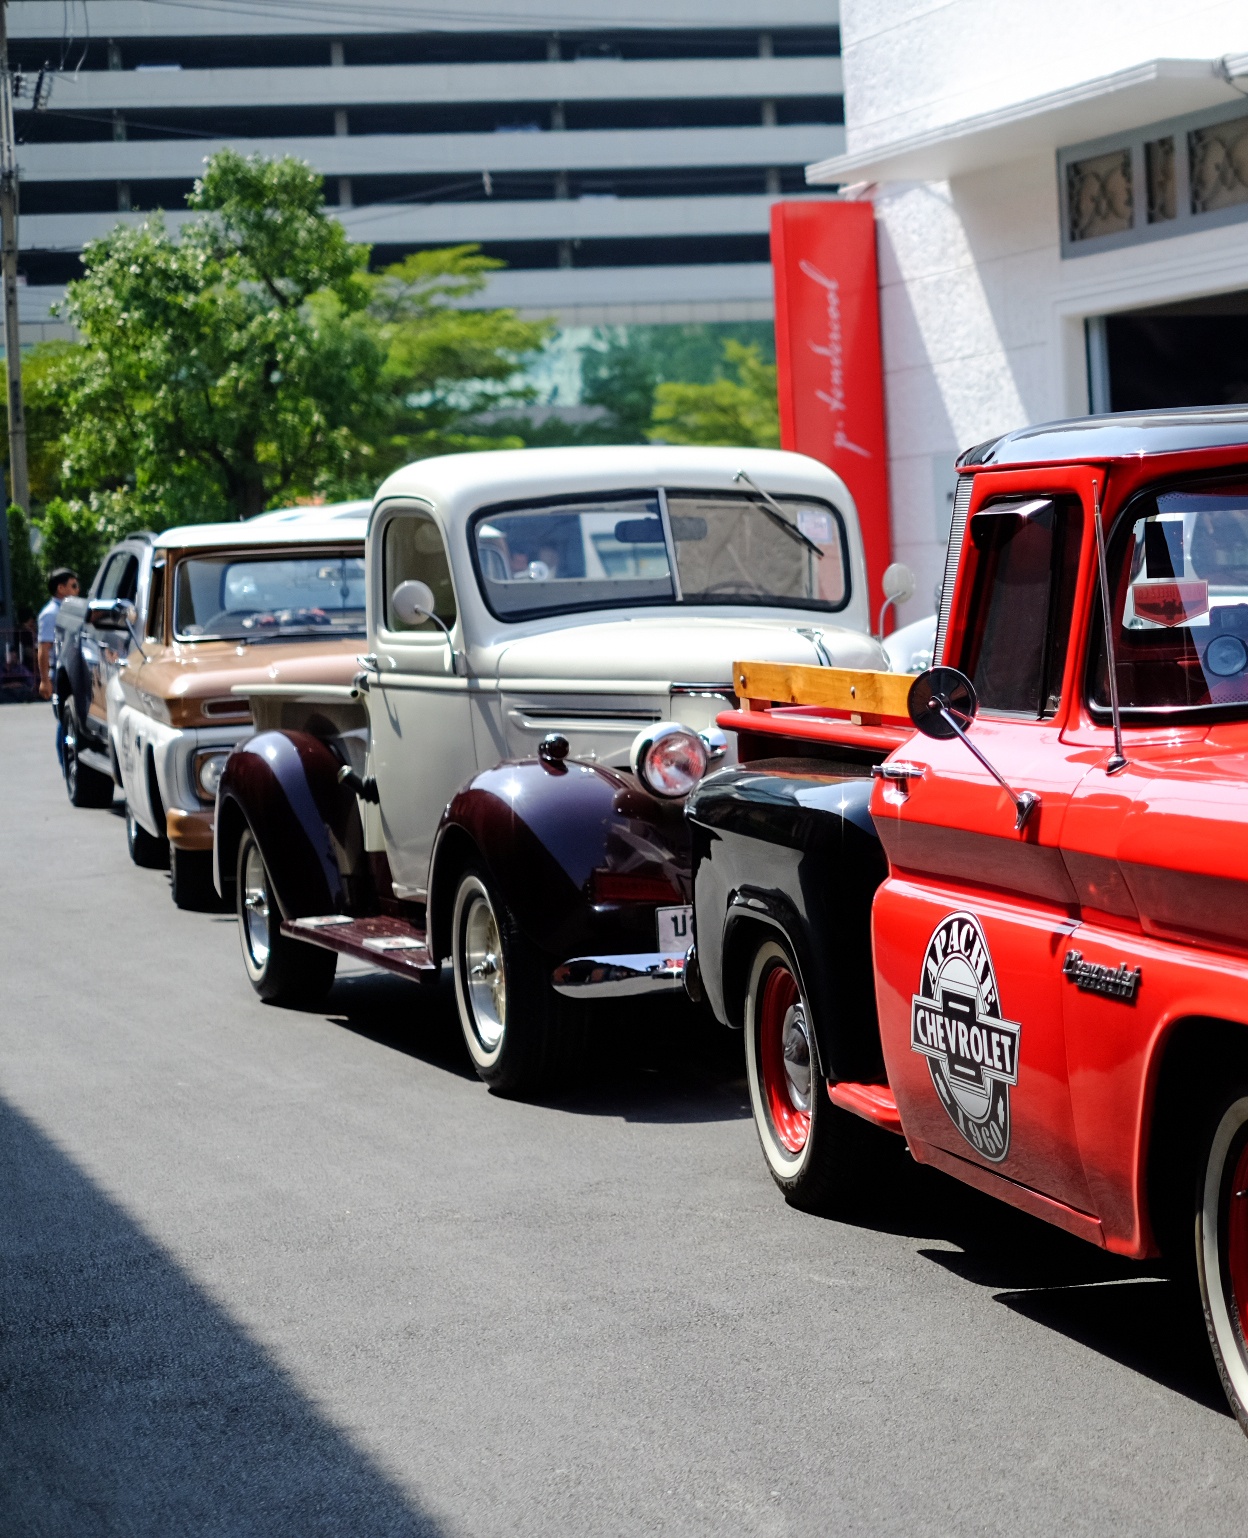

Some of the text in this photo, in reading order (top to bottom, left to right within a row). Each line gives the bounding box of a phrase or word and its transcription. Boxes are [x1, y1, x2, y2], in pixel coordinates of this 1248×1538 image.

[926, 920, 997, 1013] APACHE
[916, 1008, 1012, 1073] CHEVROLET
[956, 1105, 1004, 1155] 1960
